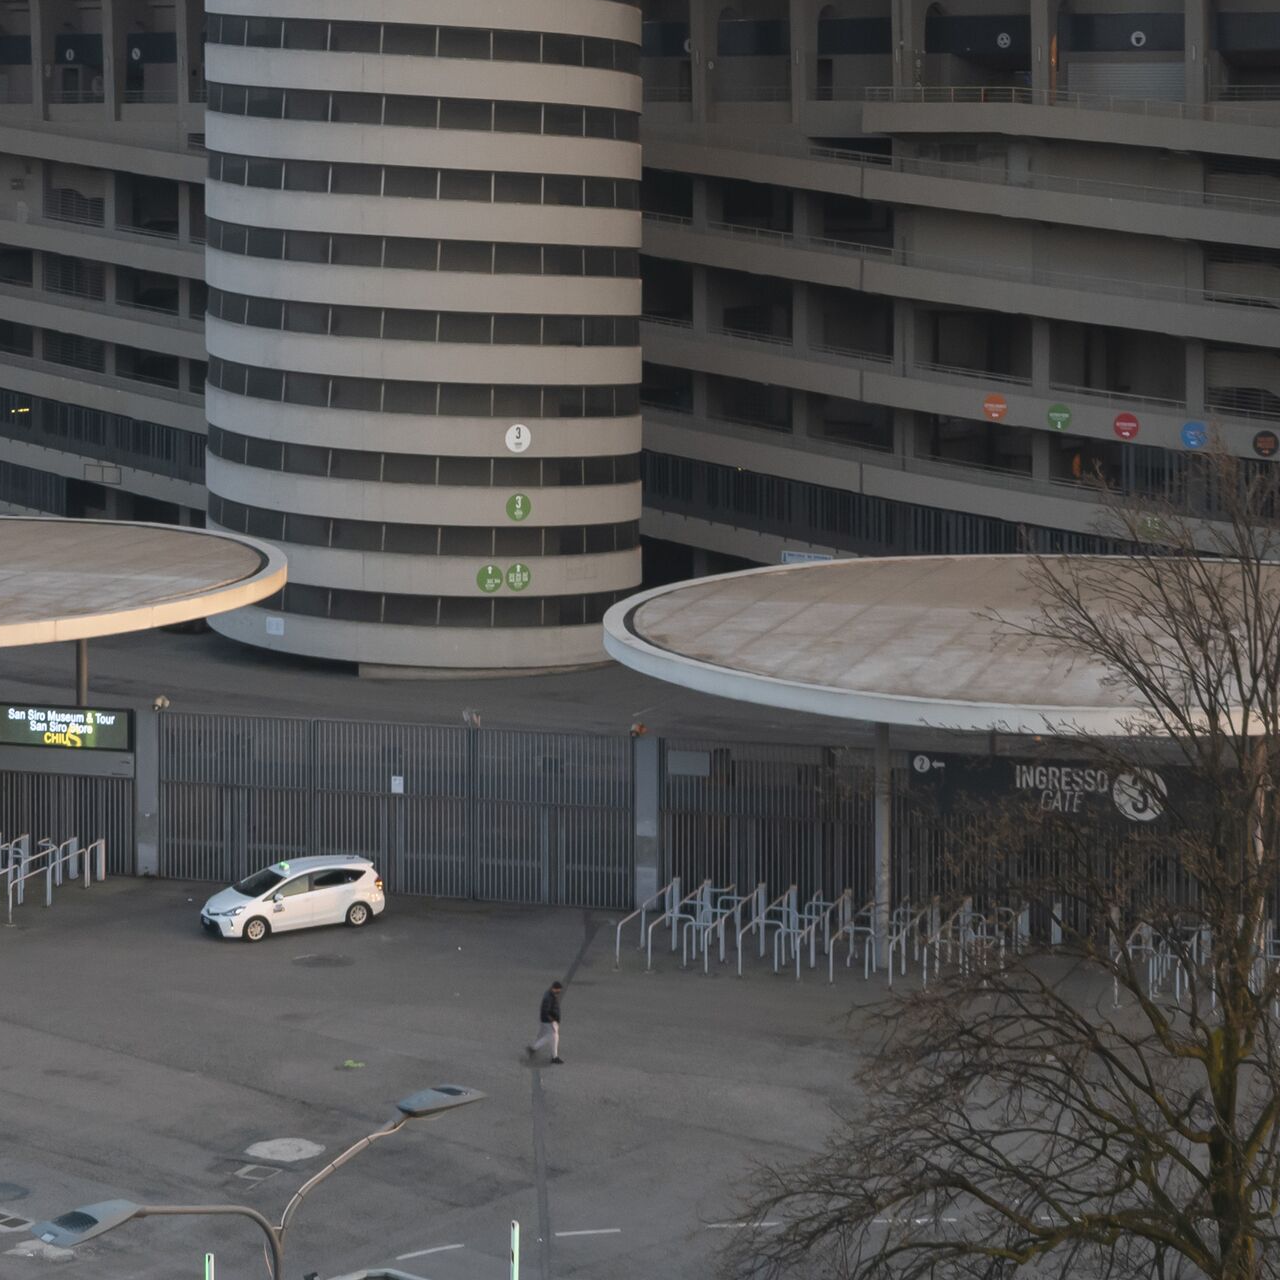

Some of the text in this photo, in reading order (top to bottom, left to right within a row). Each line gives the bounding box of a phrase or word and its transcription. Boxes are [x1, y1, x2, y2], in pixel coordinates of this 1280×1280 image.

[515, 426, 521, 440] 3
[8, 708, 115, 725] San Siro Museum & Tour
[30, 721, 47, 732] San
[49, 722, 66, 733] Siro
[1016, 765, 1108, 792] INGRESSO
[1040, 790, 1083, 813] GATE
